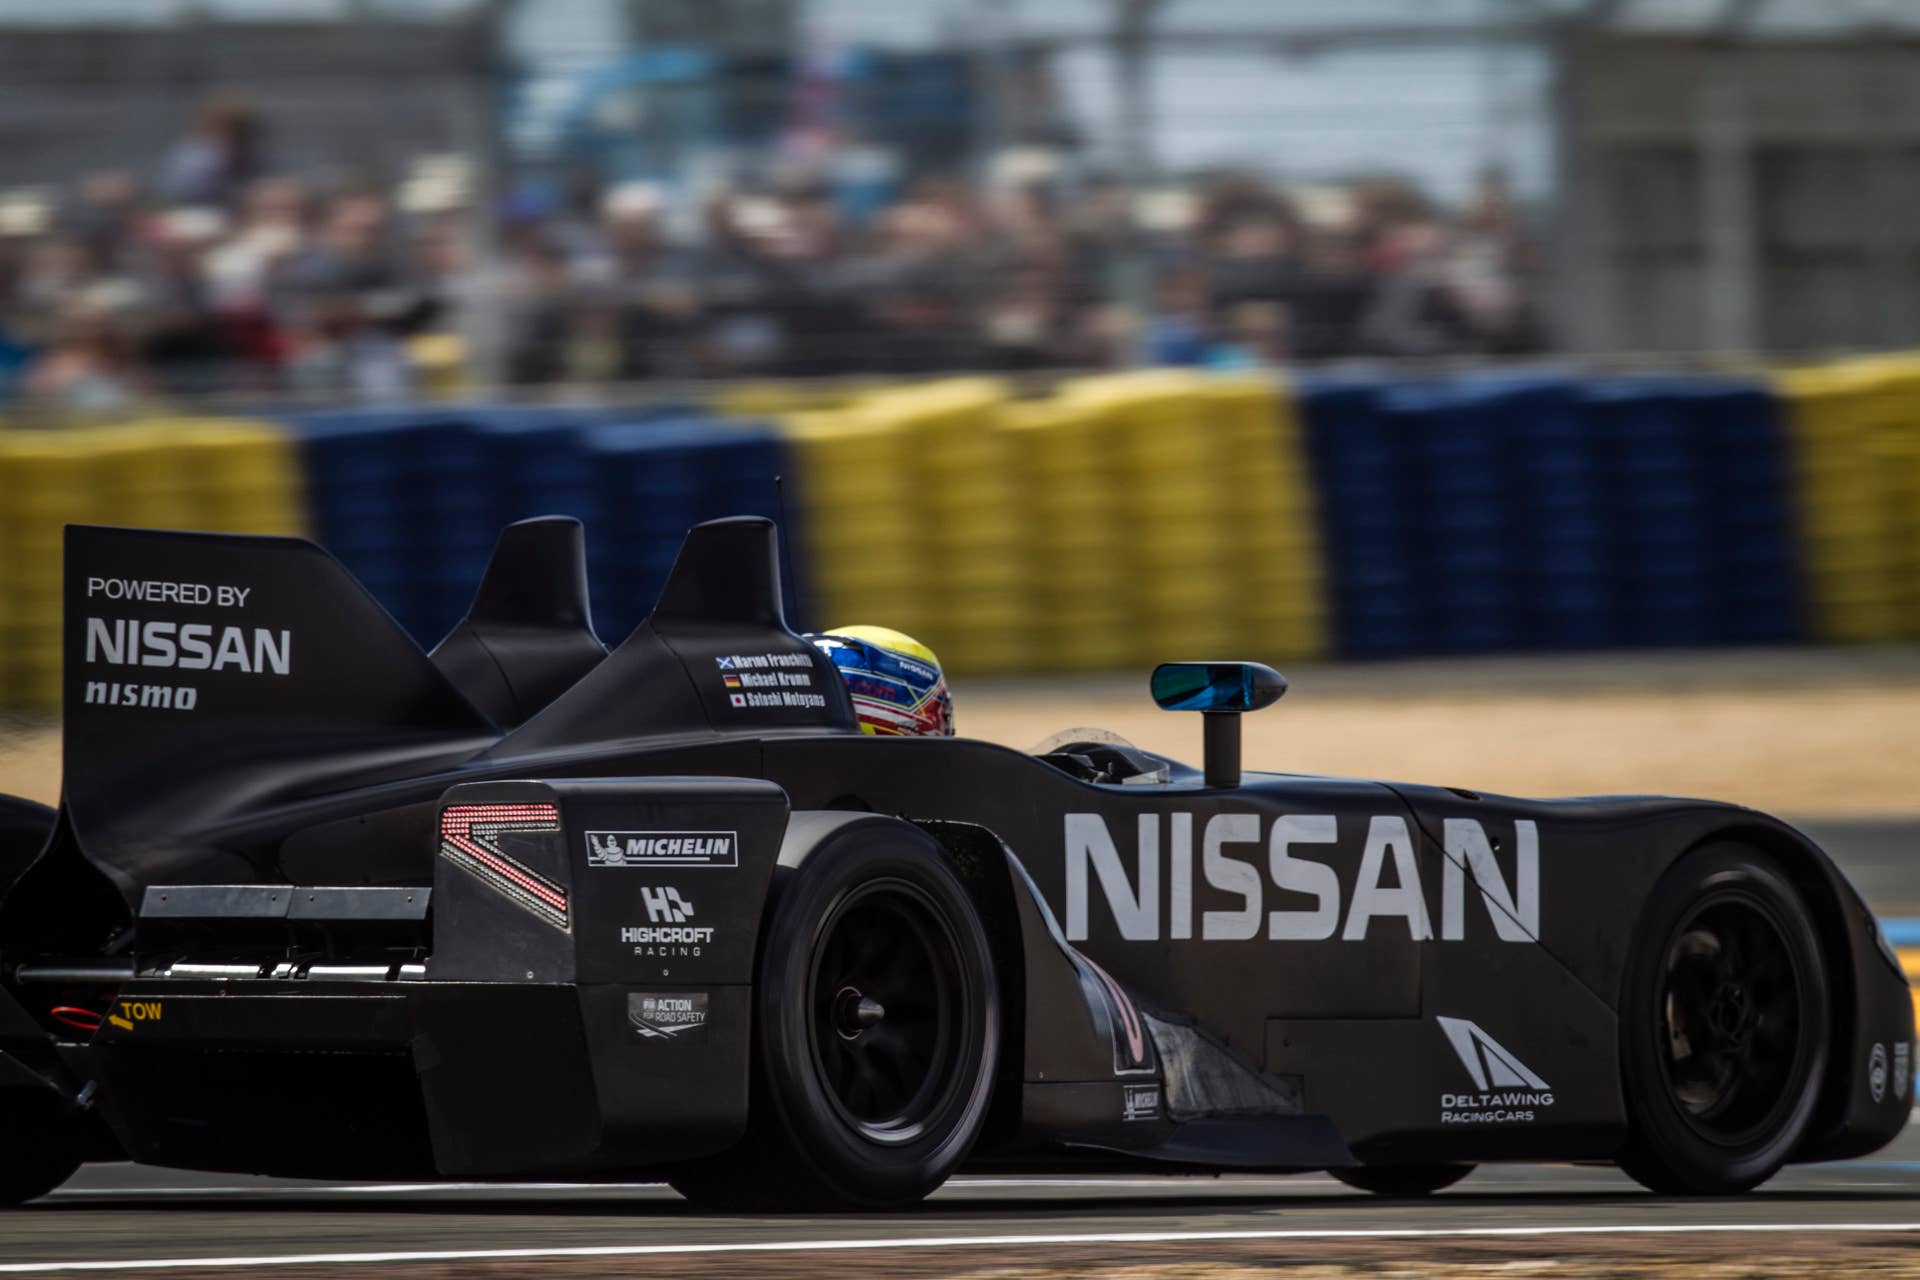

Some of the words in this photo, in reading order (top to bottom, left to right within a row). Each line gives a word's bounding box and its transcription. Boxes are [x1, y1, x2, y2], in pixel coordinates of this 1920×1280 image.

[88, 577, 211, 605] POWERED
[217, 586, 250, 608] BY
[86, 617, 291, 675] NISSAN
[740, 672, 778, 687] Michael
[85, 681, 197, 710] nismo
[746, 692, 783, 706] Satoshi
[626, 838, 730, 855] MICHELIN
[1064, 812, 1540, 943] NISSAN
[621, 927, 714, 943] HIGHCROFT
[634, 946, 701, 957] RACING
[121, 1002, 162, 1020] TOW
[658, 999, 692, 1011] ACTION
[655, 1012, 676, 1022] ROAD
[677, 1012, 705, 1022] SAFETY
